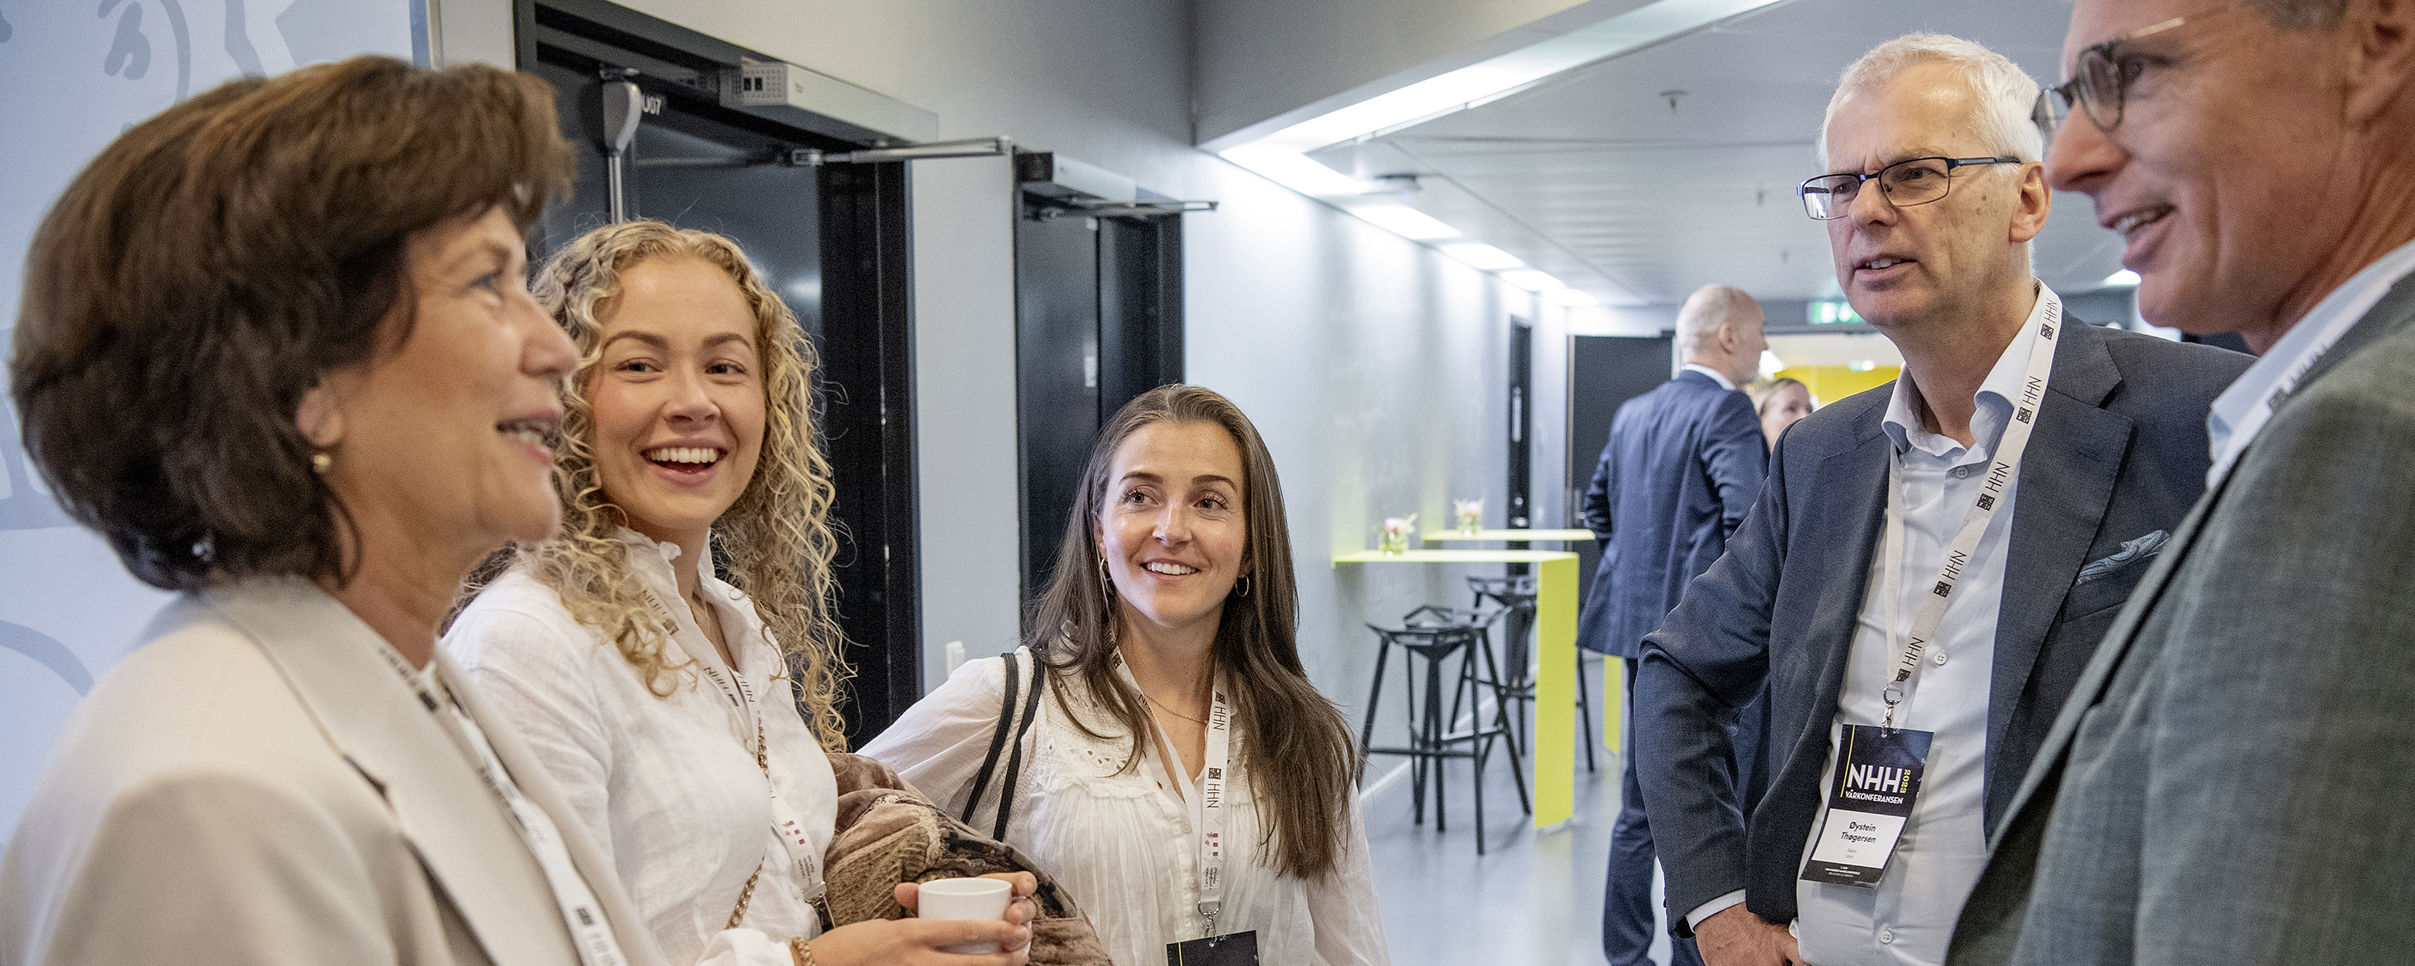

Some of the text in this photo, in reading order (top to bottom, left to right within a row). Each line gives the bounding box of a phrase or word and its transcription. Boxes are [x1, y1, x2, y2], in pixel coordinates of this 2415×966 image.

[1846, 763, 1903, 793] NHH
[1845, 789, 1904, 805] VÅRKONFERANSEN
[1849, 821, 1877, 832] Øystein
[1840, 831, 1877, 843] Thøgersen
